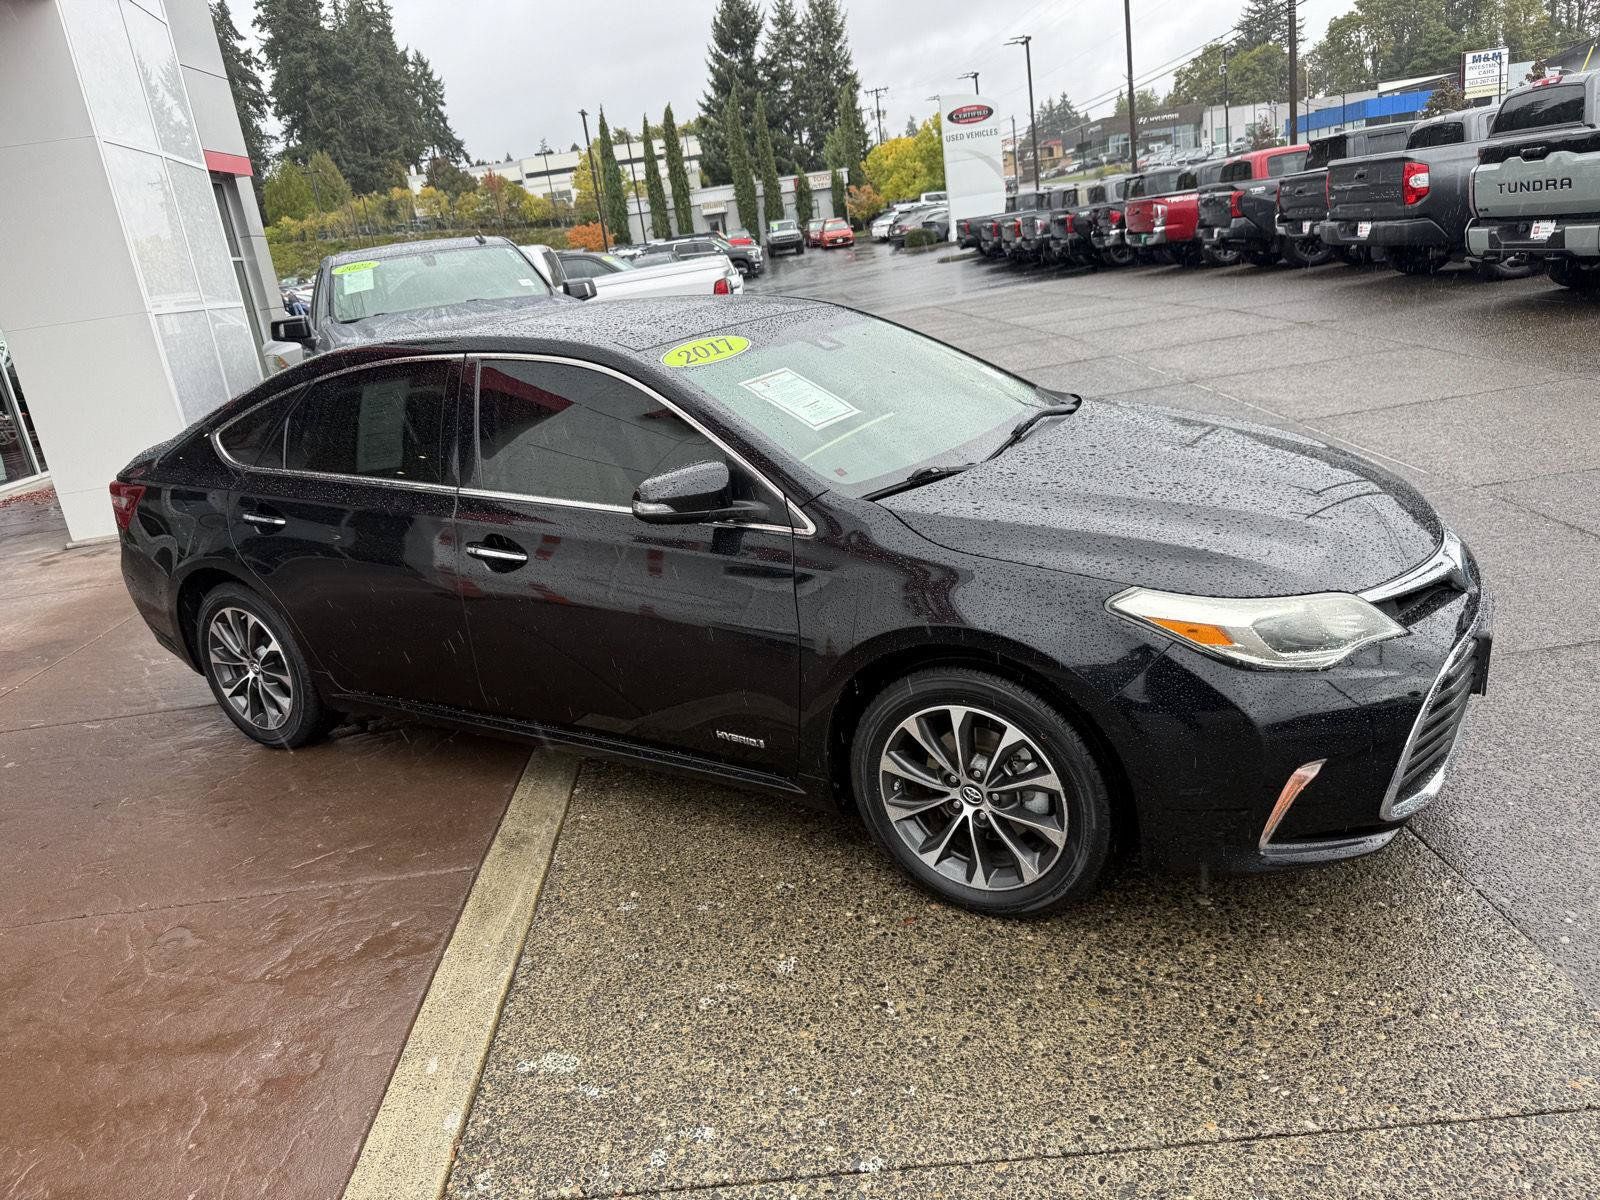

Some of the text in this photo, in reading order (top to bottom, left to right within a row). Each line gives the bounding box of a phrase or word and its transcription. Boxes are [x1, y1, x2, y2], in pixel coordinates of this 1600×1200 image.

[1472, 52, 1502, 63] M&M
[952, 109, 989, 120] CERTIFIED
[1149, 113, 1179, 122] HYUNDAI
[945, 128, 999, 143] USED VEHICLES
[1496, 178, 1573, 194] TUNDRA
[678, 338, 734, 365] 2017
[716, 730, 757, 747] HYBRID
